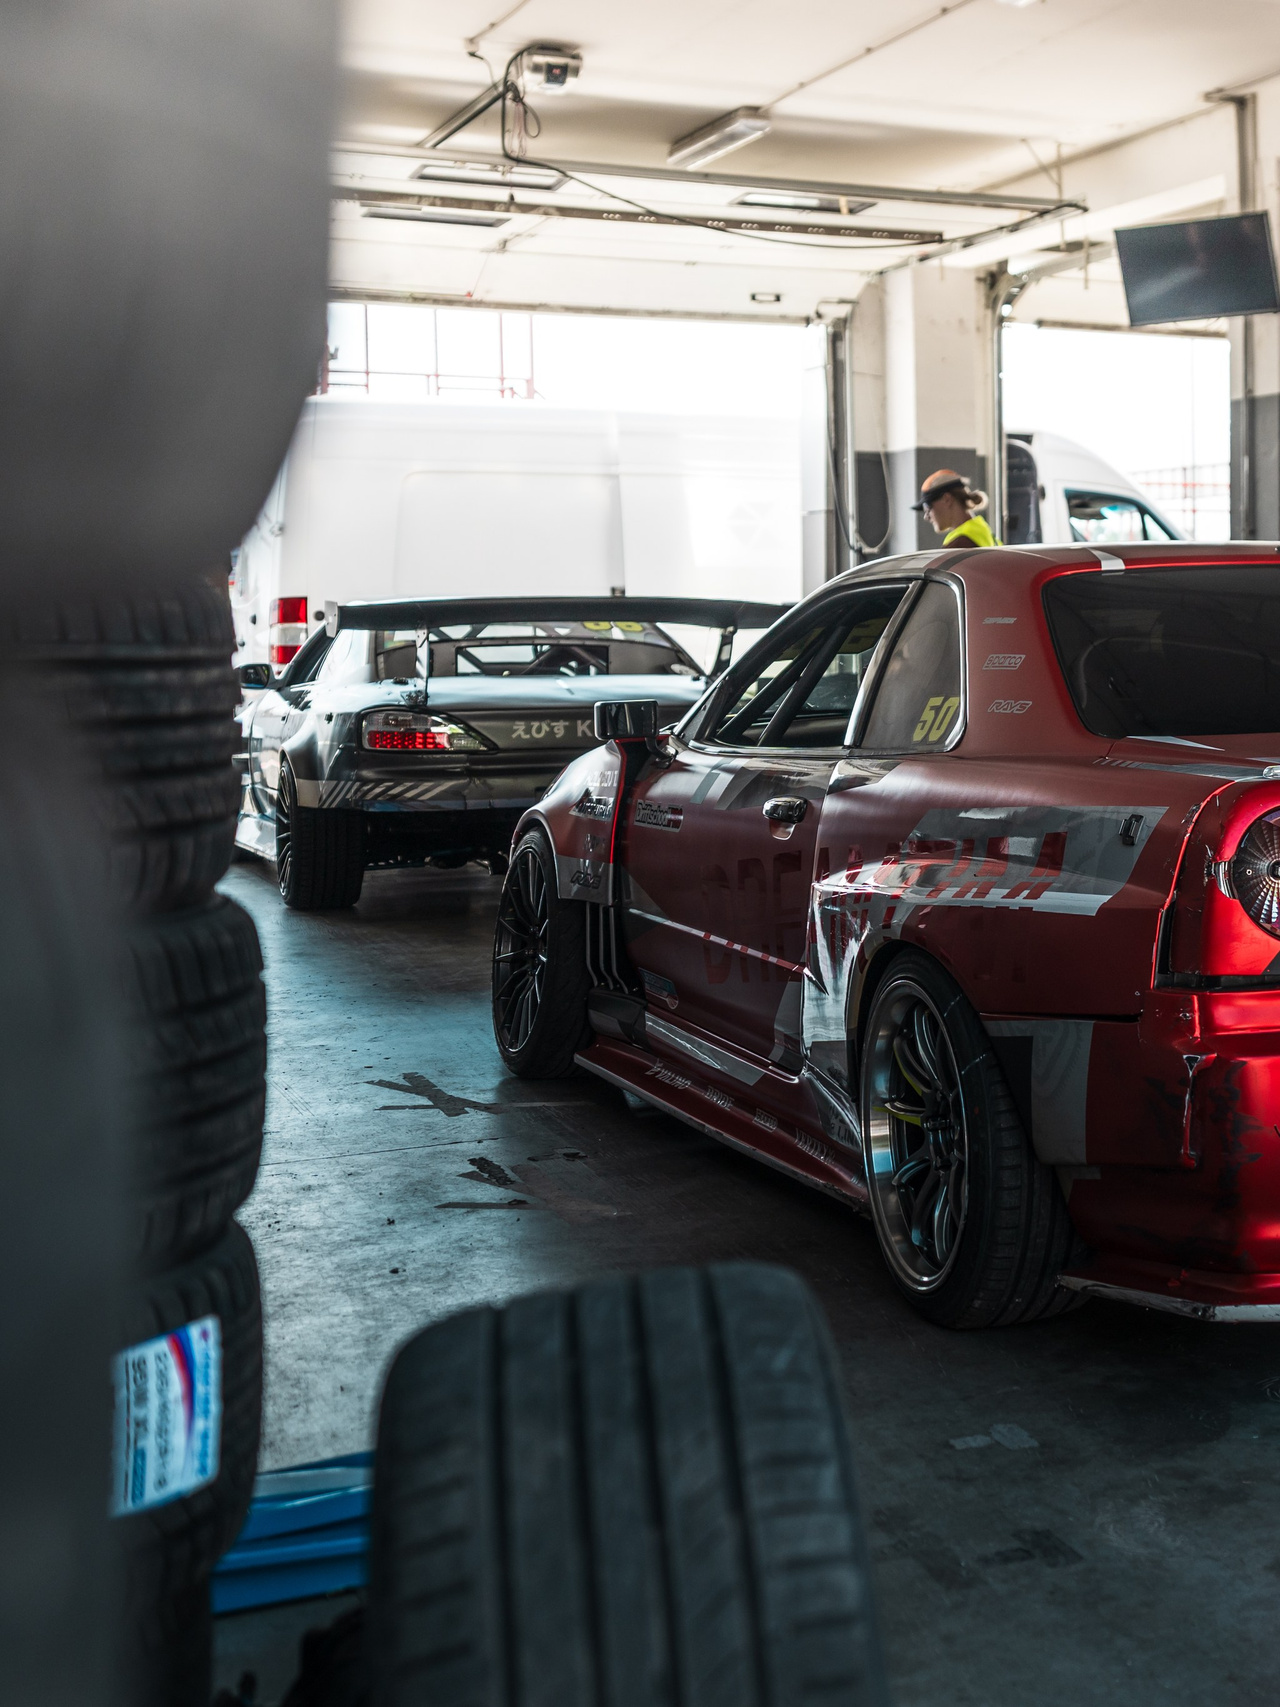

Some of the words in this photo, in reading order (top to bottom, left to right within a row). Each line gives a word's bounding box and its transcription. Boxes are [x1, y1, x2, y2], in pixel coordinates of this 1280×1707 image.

[988, 700, 1032, 714] RAYS
[512, 719, 569, 739] えびす
[912, 696, 960, 744] 50
